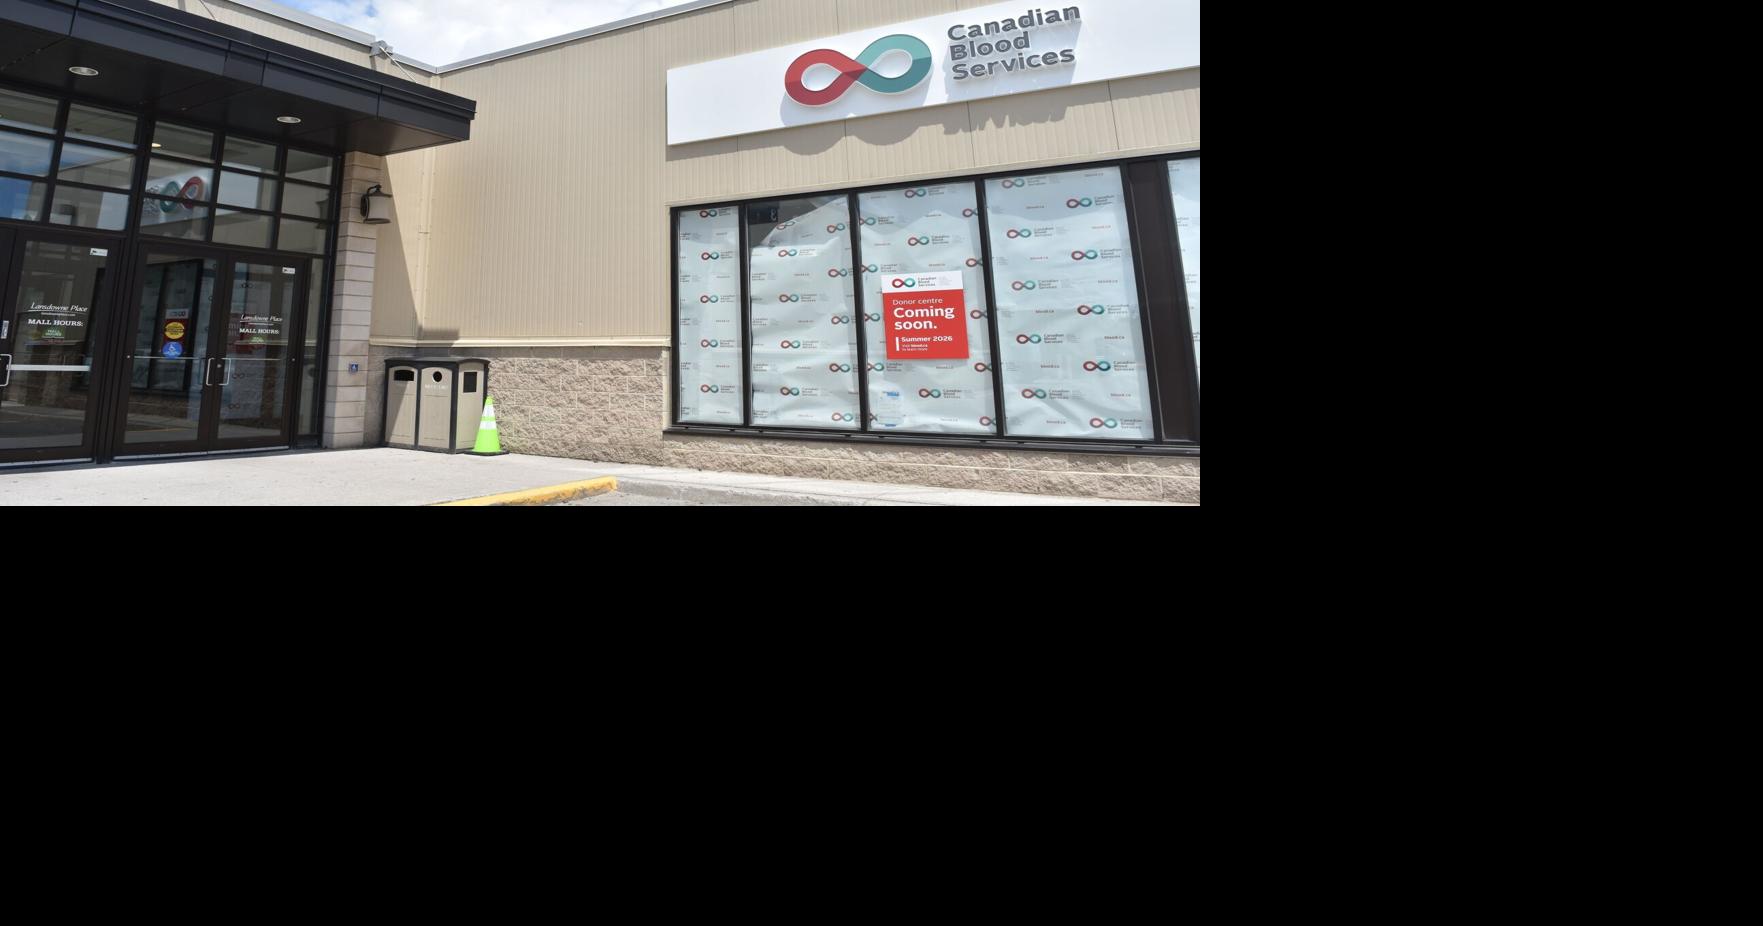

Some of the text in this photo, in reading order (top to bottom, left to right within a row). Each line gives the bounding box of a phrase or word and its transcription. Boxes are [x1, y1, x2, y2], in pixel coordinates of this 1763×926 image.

[947, 5, 1081, 41] Canadian
[950, 31, 1030, 61] Blood
[952, 49, 1075, 81] Services
[30, 301, 69, 311] Lansdowne
[893, 306, 955, 319] Coming
[53, 319, 83, 327] HOURS:
[894, 320, 937, 330] soon.
